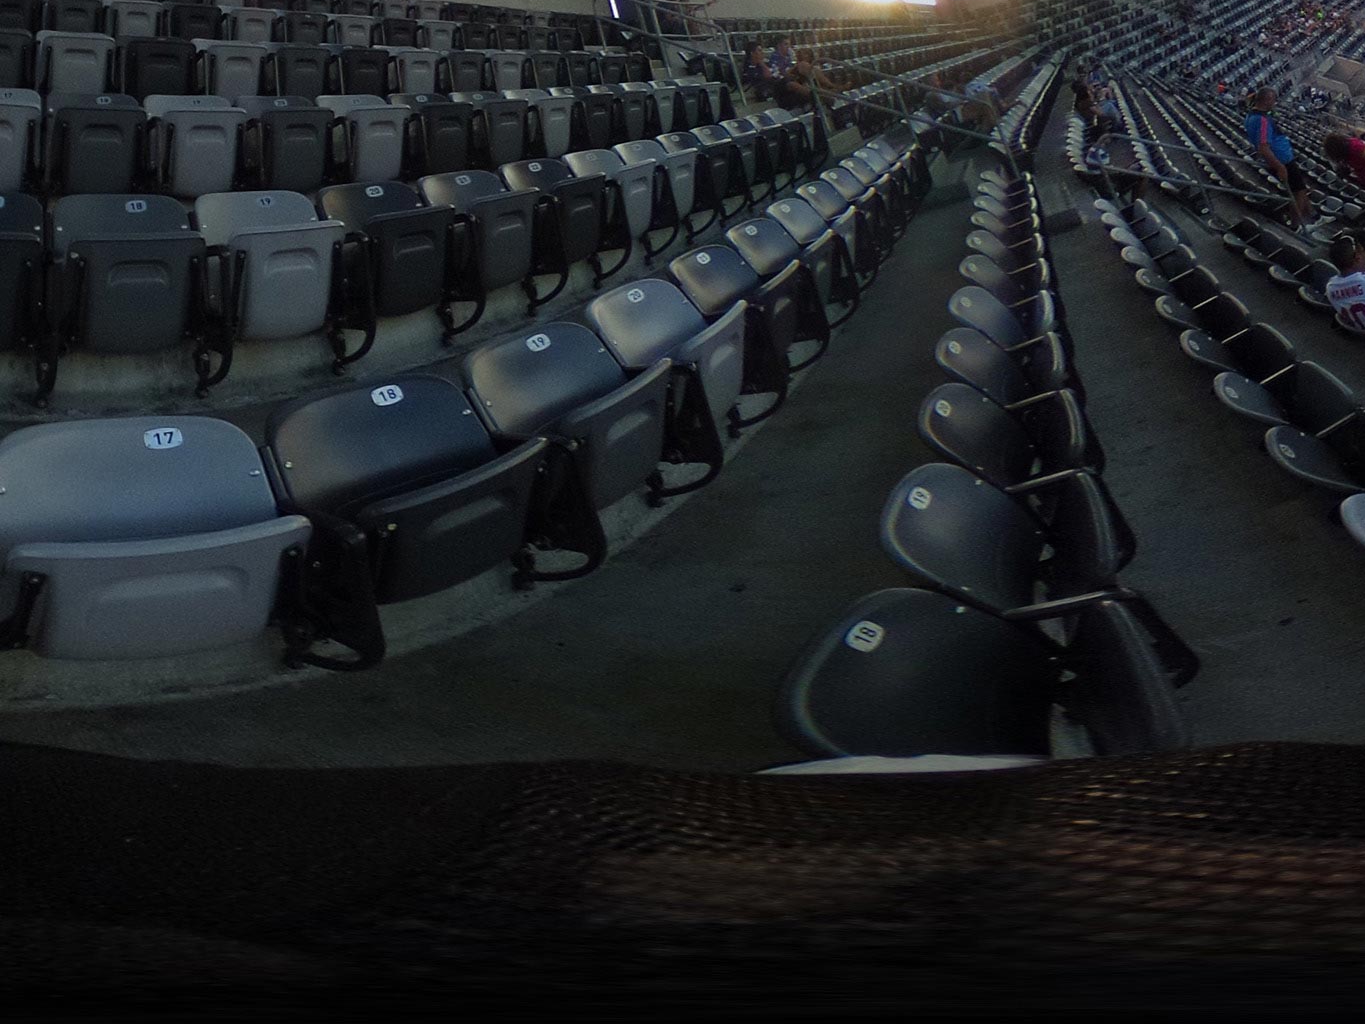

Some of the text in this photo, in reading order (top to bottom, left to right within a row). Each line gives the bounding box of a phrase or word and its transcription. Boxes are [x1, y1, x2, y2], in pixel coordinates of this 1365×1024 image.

[531, 336, 545, 350] 19
[378, 388, 397, 403] 18
[152, 431, 174, 445] 17
[913, 491, 928, 505] 19
[854, 626, 877, 644] 18
